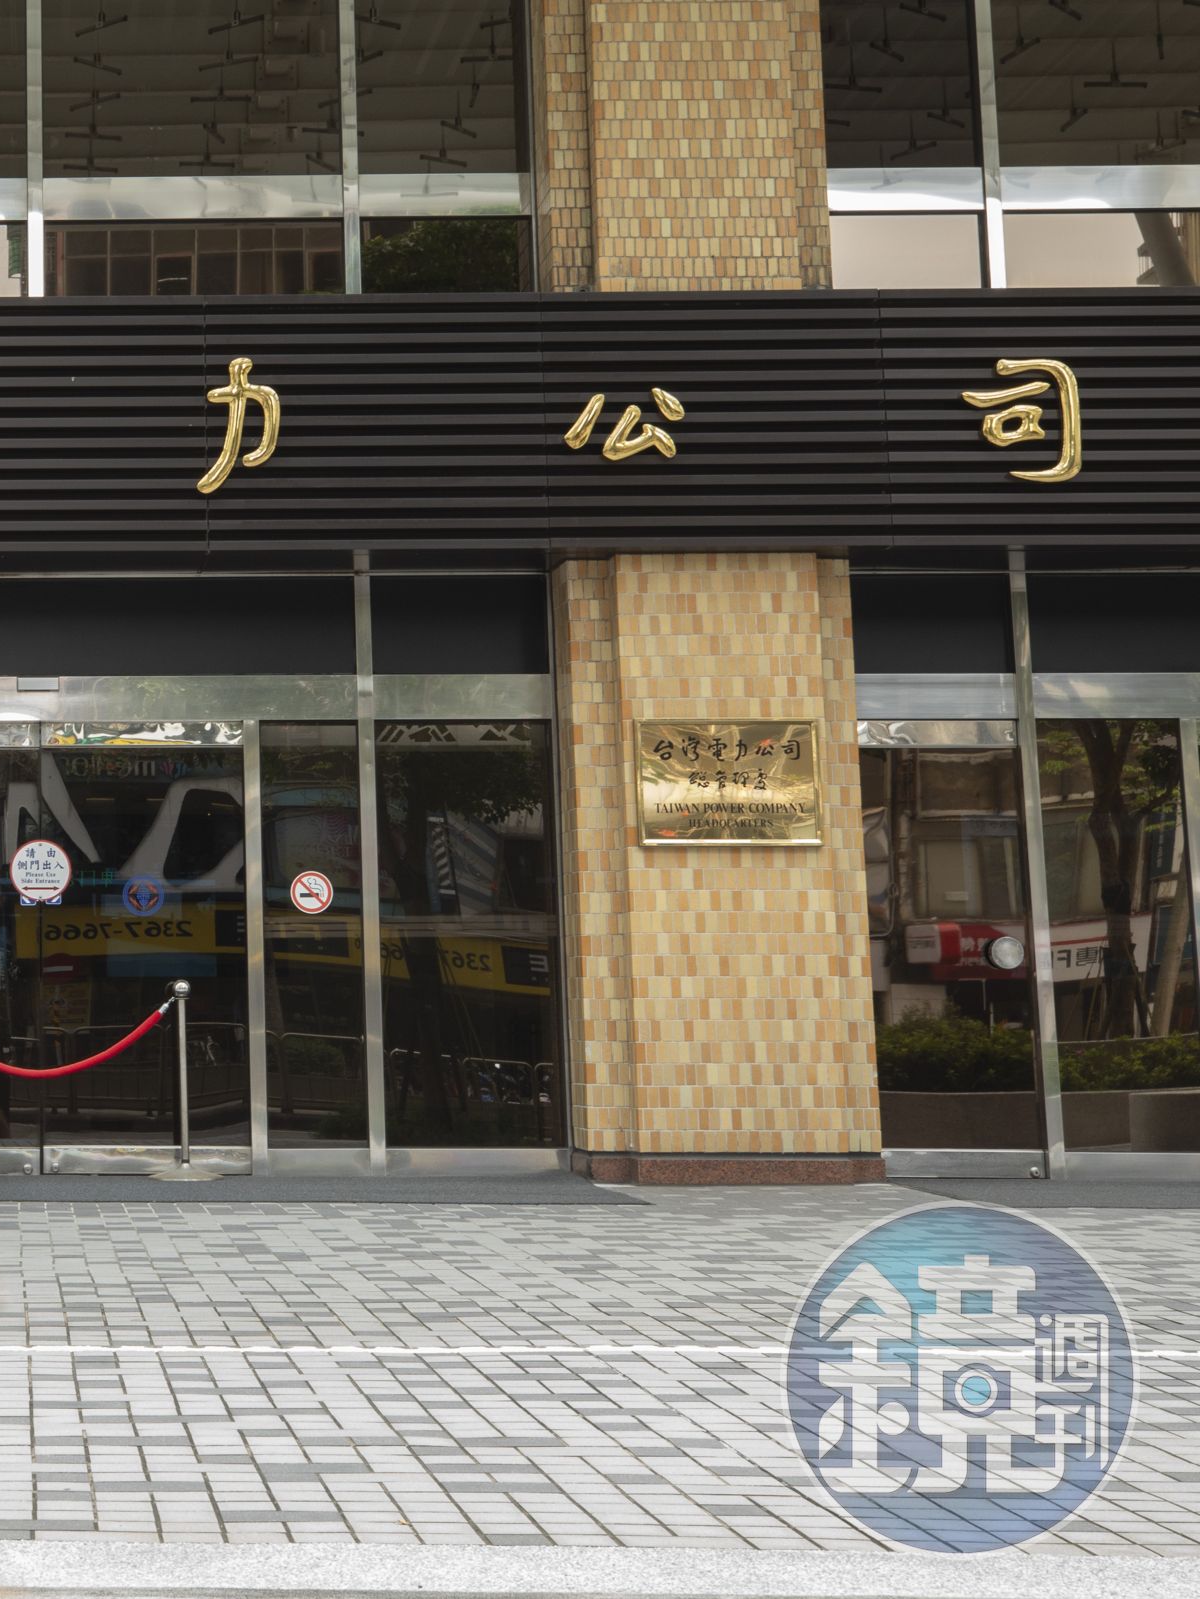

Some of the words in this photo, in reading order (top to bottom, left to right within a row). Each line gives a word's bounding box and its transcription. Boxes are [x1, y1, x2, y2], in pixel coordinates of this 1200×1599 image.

[656, 802, 700, 814] TAIWAN
[703, 802, 745, 814] POWER
[749, 802, 806, 814] COMPANY
[688, 818, 774, 829] HEADQUARTERS
[17, 860, 64, 871] 側門出入
